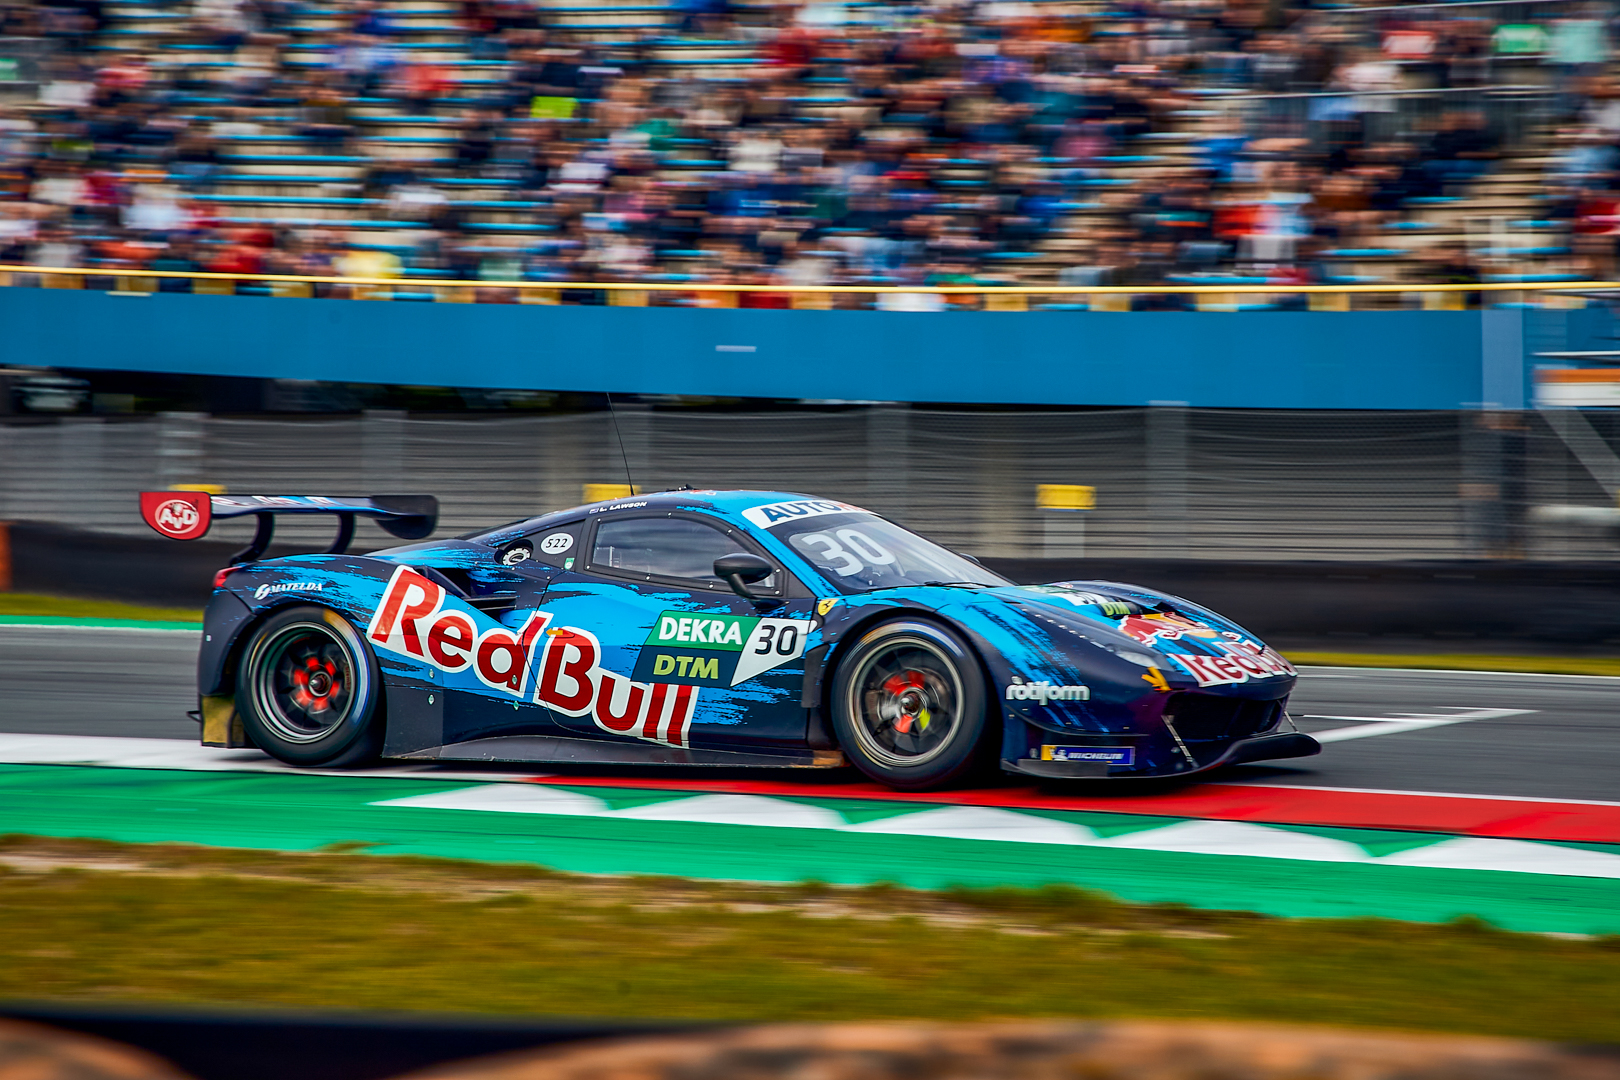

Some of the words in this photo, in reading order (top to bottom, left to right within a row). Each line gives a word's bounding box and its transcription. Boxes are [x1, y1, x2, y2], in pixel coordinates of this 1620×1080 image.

[609, 501, 648, 511] LAWSON
[545, 538, 568, 549] 522
[801, 529, 896, 577] 30
[658, 616, 743, 646] DEKRA
[754, 614, 799, 656] 30
[370, 567, 548, 693] Red
[538, 628, 694, 747] Bull
[652, 654, 719, 680] DTM
[1005, 678, 1091, 706] rotiform
